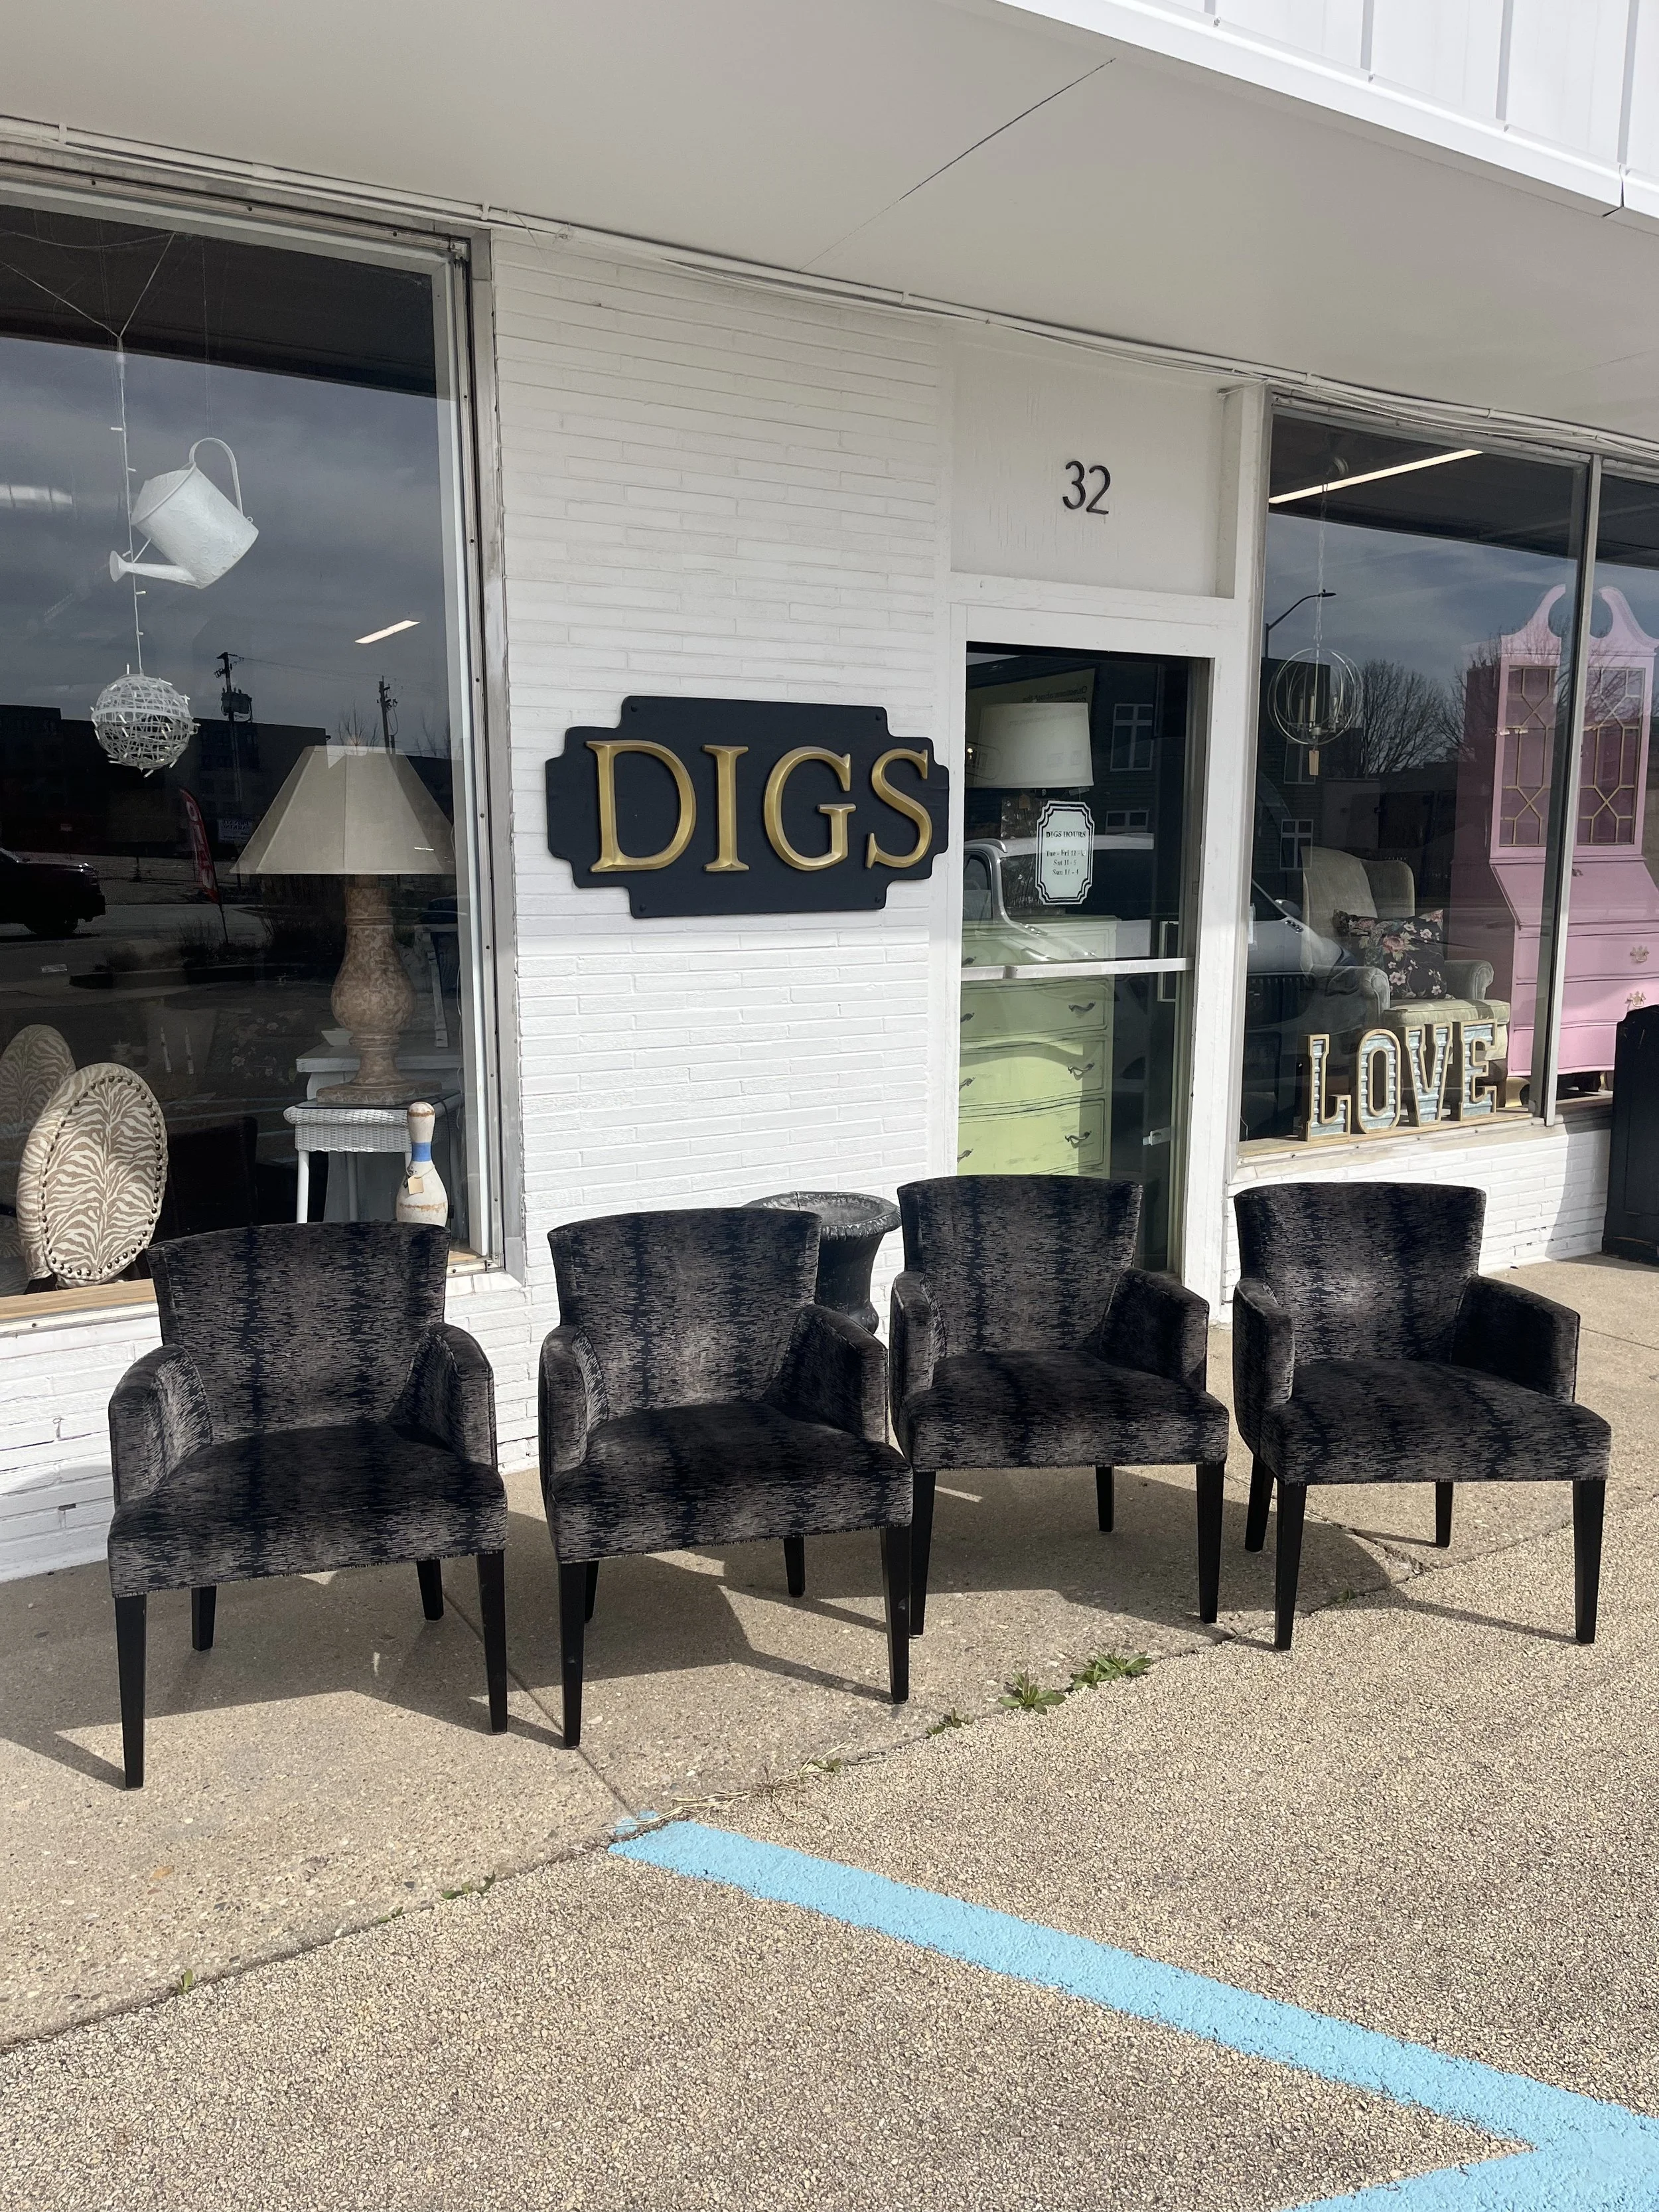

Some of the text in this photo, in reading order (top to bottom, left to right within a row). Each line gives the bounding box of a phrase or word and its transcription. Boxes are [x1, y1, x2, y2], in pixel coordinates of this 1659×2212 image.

[1062, 461, 1111, 515] 32
[585, 739, 932, 873] DIGS
[1303, 1018, 1497, 1142] LOVE
